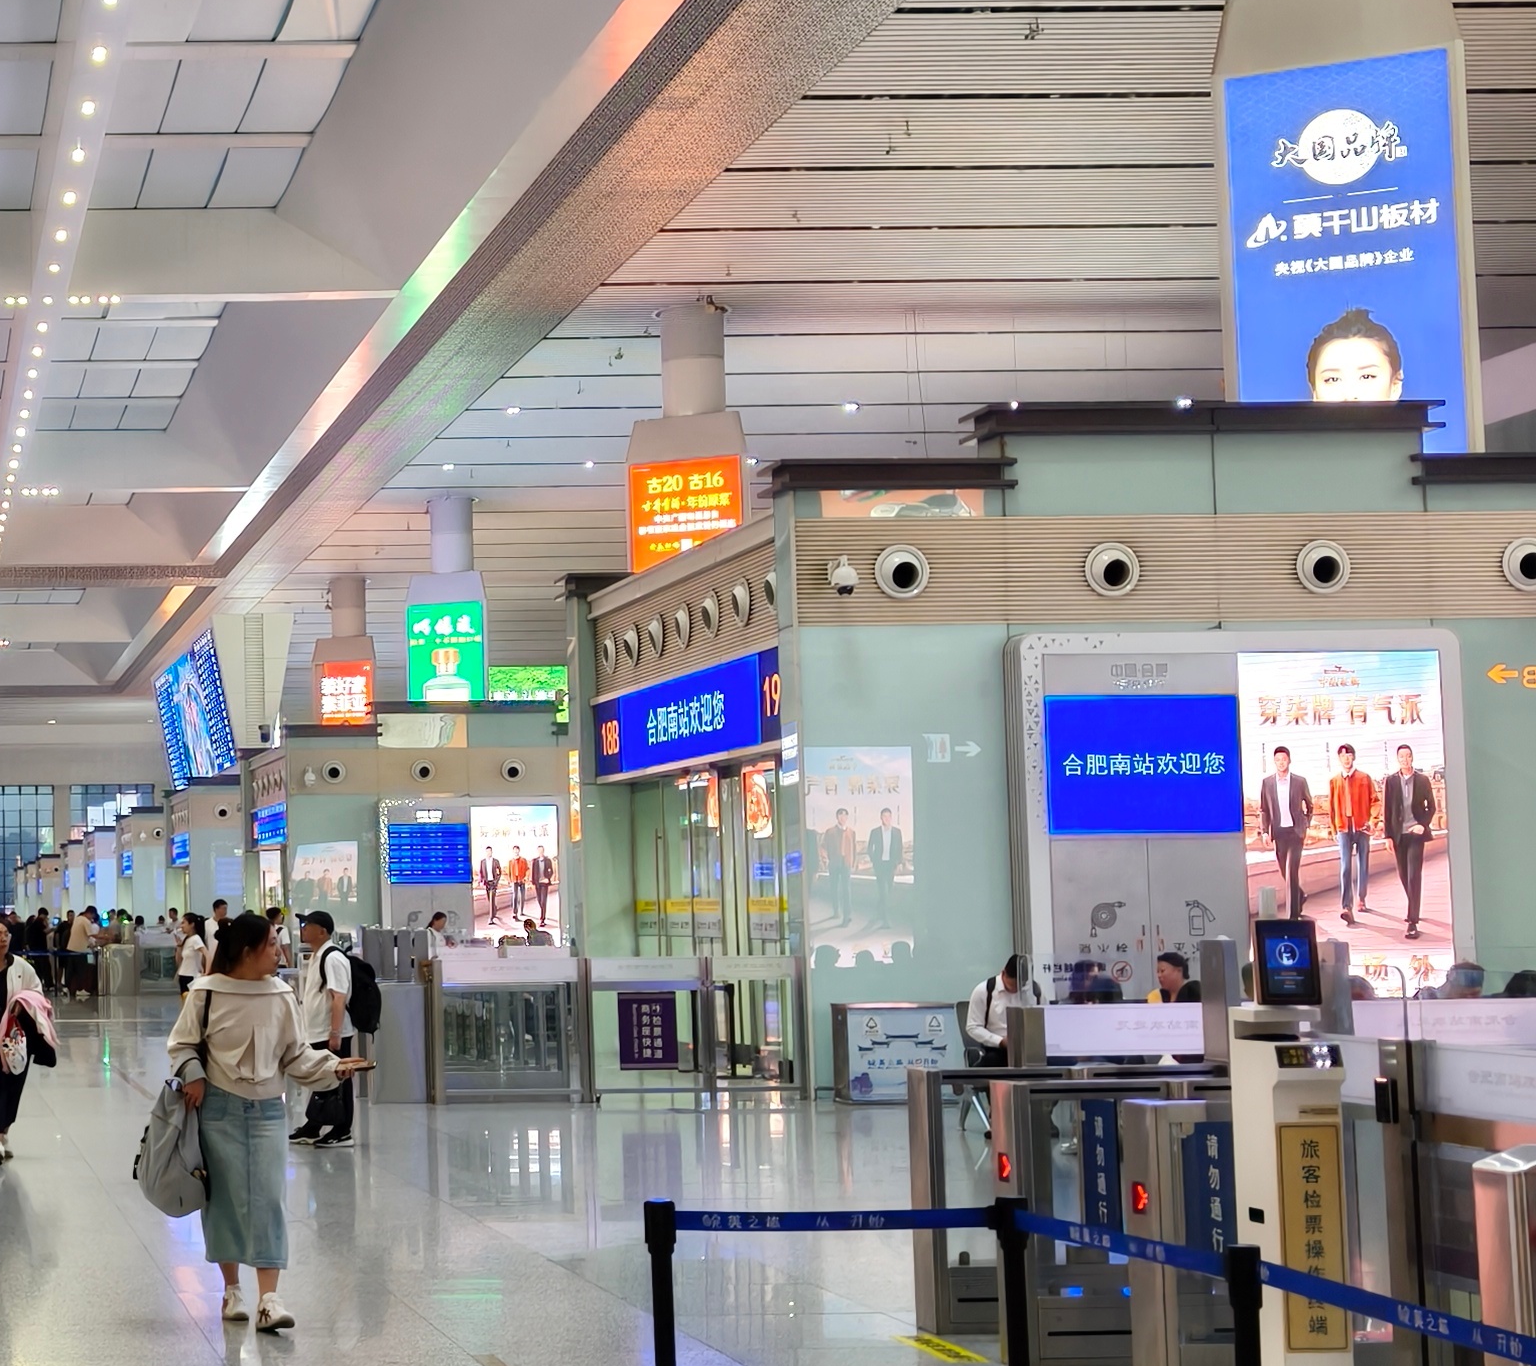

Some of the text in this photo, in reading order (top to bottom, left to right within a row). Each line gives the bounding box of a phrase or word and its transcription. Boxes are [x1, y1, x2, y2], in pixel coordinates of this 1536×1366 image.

[1292, 198, 1440, 239] 莫干山板材
[646, 471, 724, 494] 古20 古16
[646, 690, 726, 746] 合肥南站欢迎您
[1258, 694, 1425, 726] 穿柒牌 有气派
[601, 720, 620, 756] 18B
[1062, 752, 1226, 776] 合肥南站欢迎您
[1094, 1115, 1108, 1224] 请勿通行
[1206, 1134, 1224, 1254] 请勿通行
